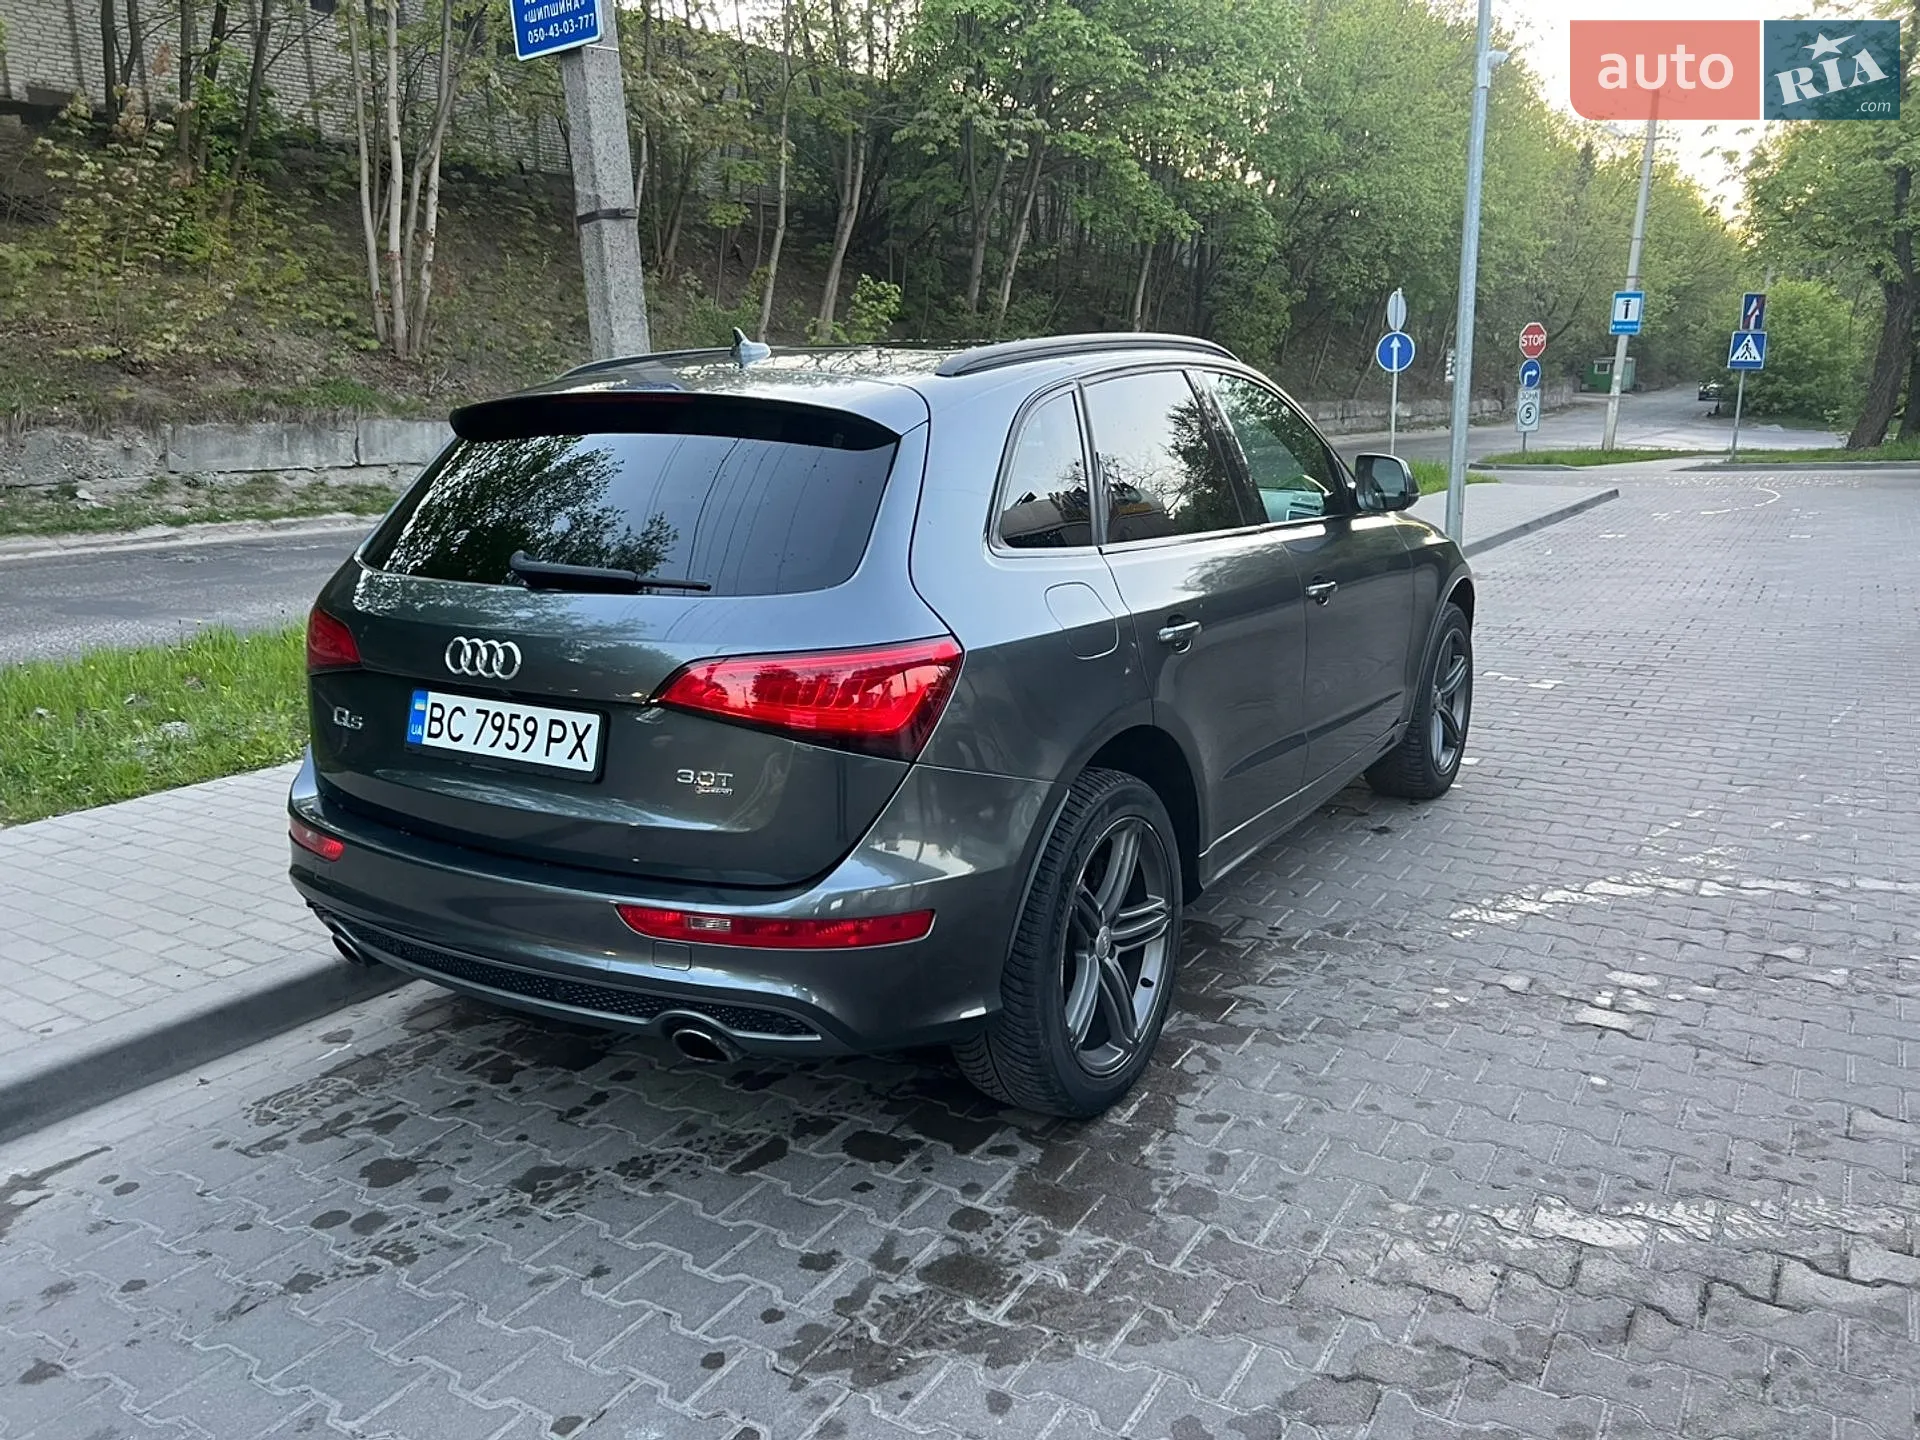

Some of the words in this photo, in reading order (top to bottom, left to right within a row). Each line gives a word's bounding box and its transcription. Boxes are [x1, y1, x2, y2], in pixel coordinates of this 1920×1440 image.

[527, 13, 595, 44] 050-43-03-777
[1521, 334, 1546, 347] STOP
[1524, 406, 1533, 419] 5
[334, 706, 363, 729] Q5
[411, 723, 422, 736] UA
[427, 702, 466, 742] BC
[473, 708, 538, 753] 7959
[545, 718, 592, 762] PX
[676, 769, 734, 787] 3.0T
